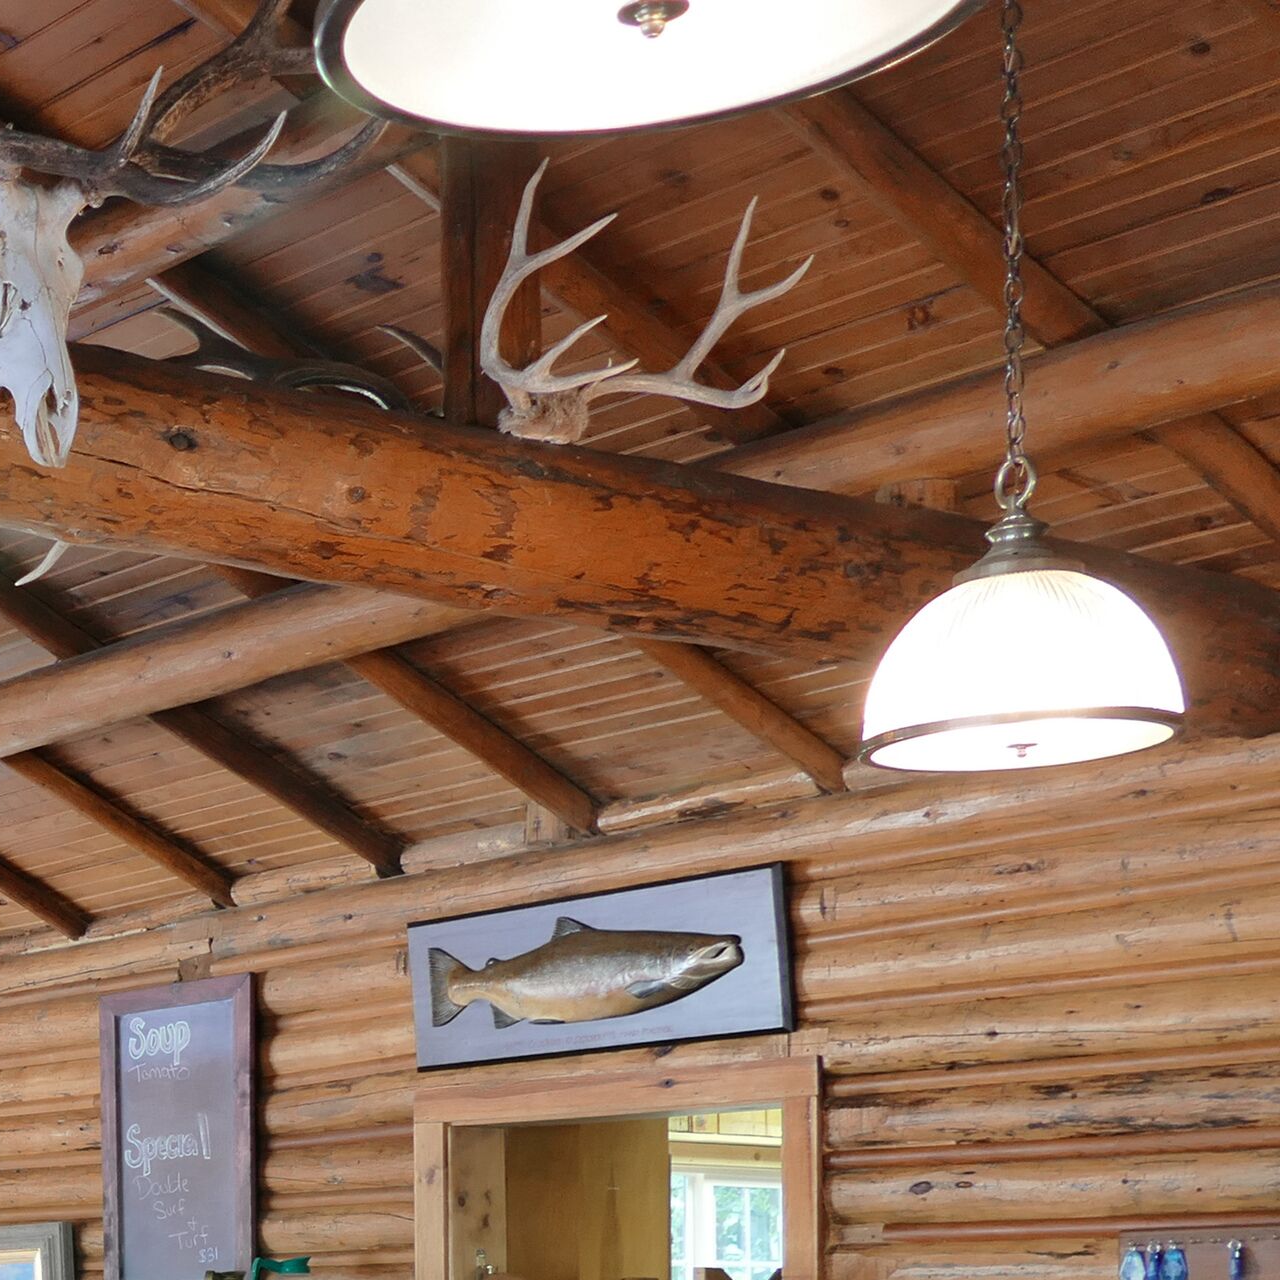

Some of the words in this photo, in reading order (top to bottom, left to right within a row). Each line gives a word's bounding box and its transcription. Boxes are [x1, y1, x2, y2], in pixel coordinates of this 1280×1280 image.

[129, 1018, 191, 1066] Soup
[128, 1063, 190, 1082] Tomato
[125, 1113, 211, 1176] Special
[134, 1172, 189, 1199] Double
[153, 1200, 186, 1219] Surf
[168, 1226, 208, 1249] Turf
[199, 1247, 218, 1263] $31
